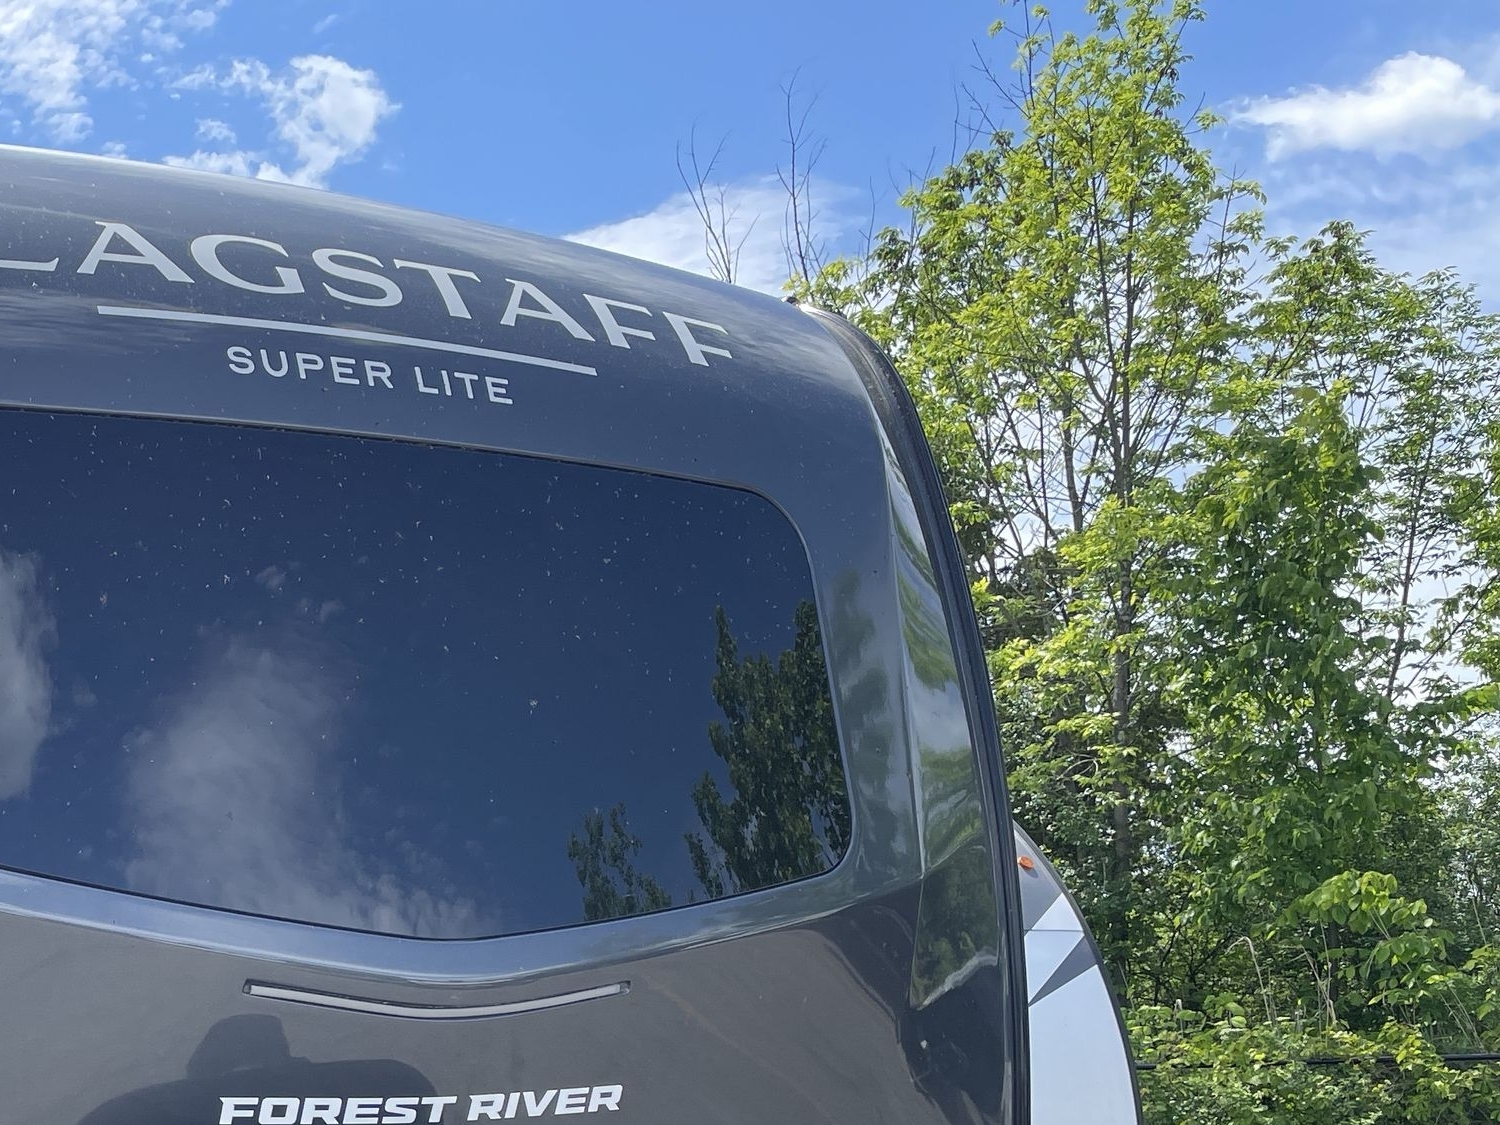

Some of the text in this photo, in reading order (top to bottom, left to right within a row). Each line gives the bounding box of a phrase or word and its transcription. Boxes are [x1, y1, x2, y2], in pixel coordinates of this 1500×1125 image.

[226, 346, 513, 405] SUPER LITE
[219, 1084, 623, 1125] FOREST RIVER
